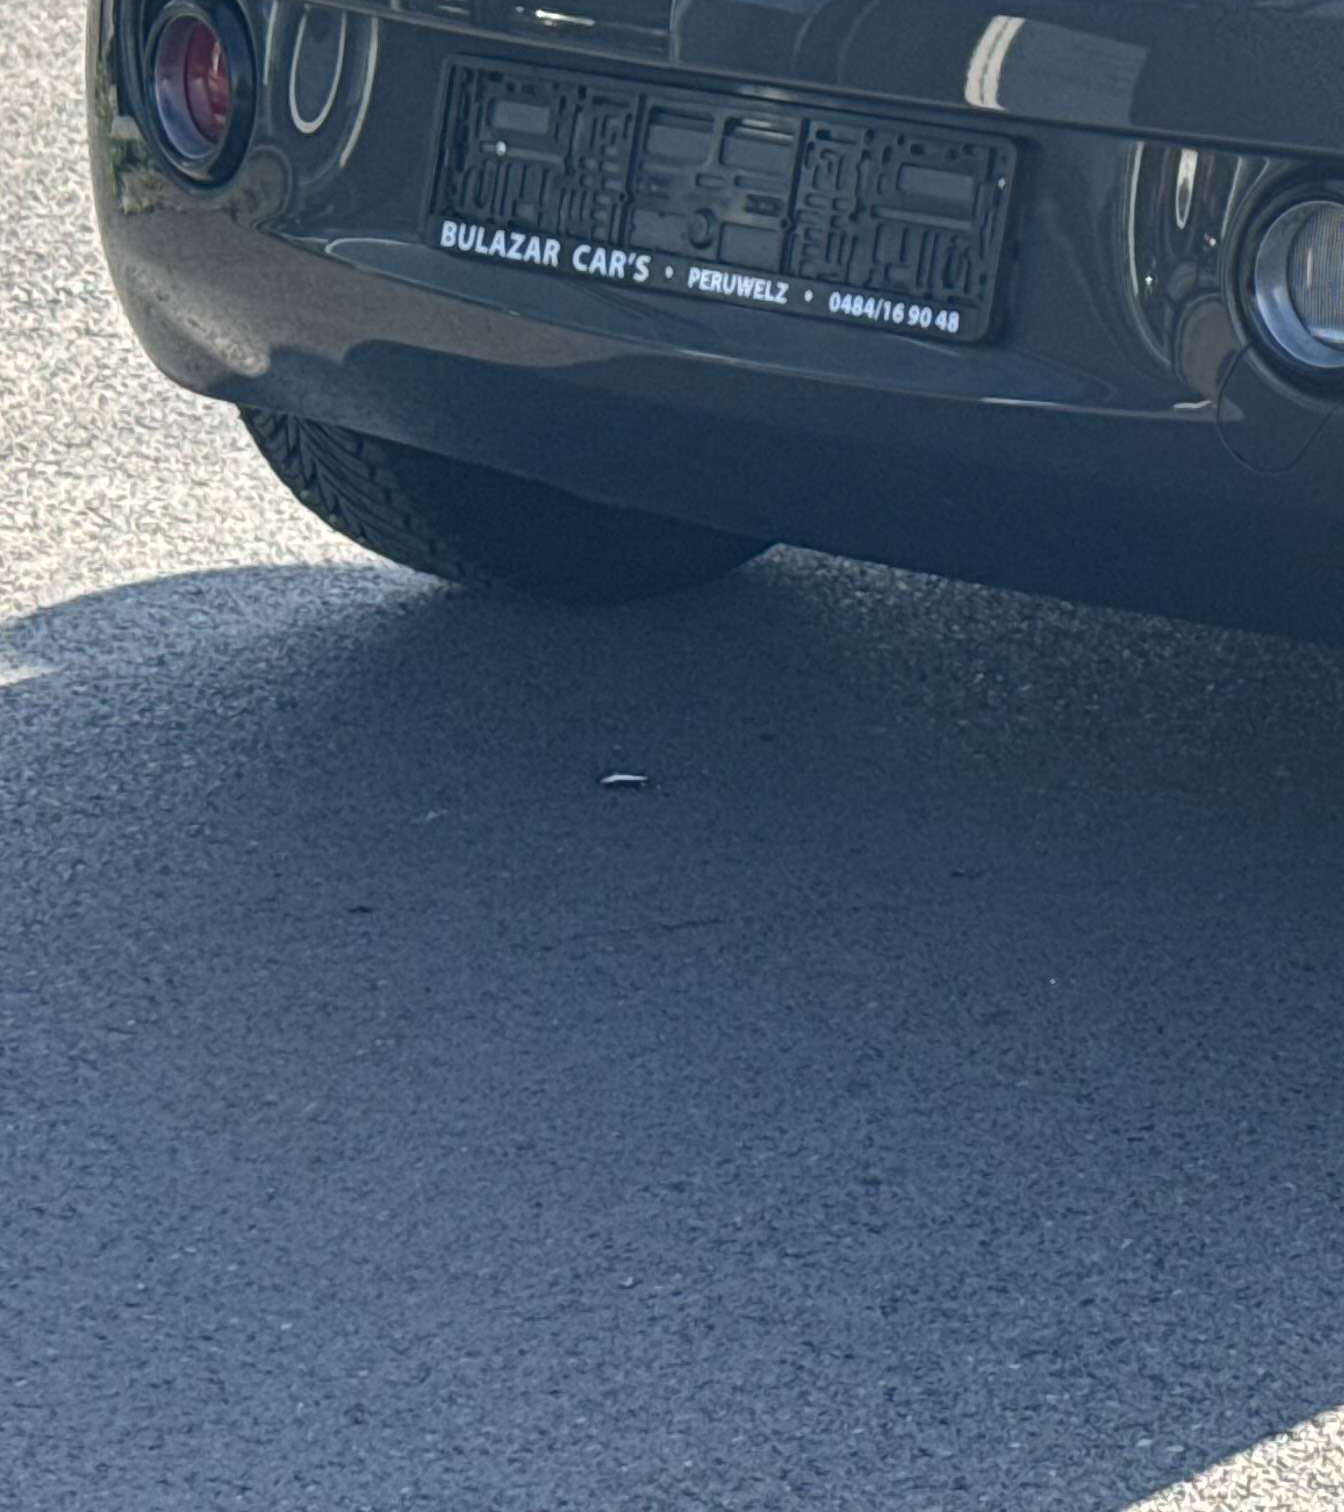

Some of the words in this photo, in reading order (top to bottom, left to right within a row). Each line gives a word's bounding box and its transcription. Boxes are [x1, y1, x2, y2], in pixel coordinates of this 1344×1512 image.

[440, 220, 561, 267] BULAZAR
[572, 244, 651, 282] CAR'S
[687, 266, 790, 305] PERUWELZ
